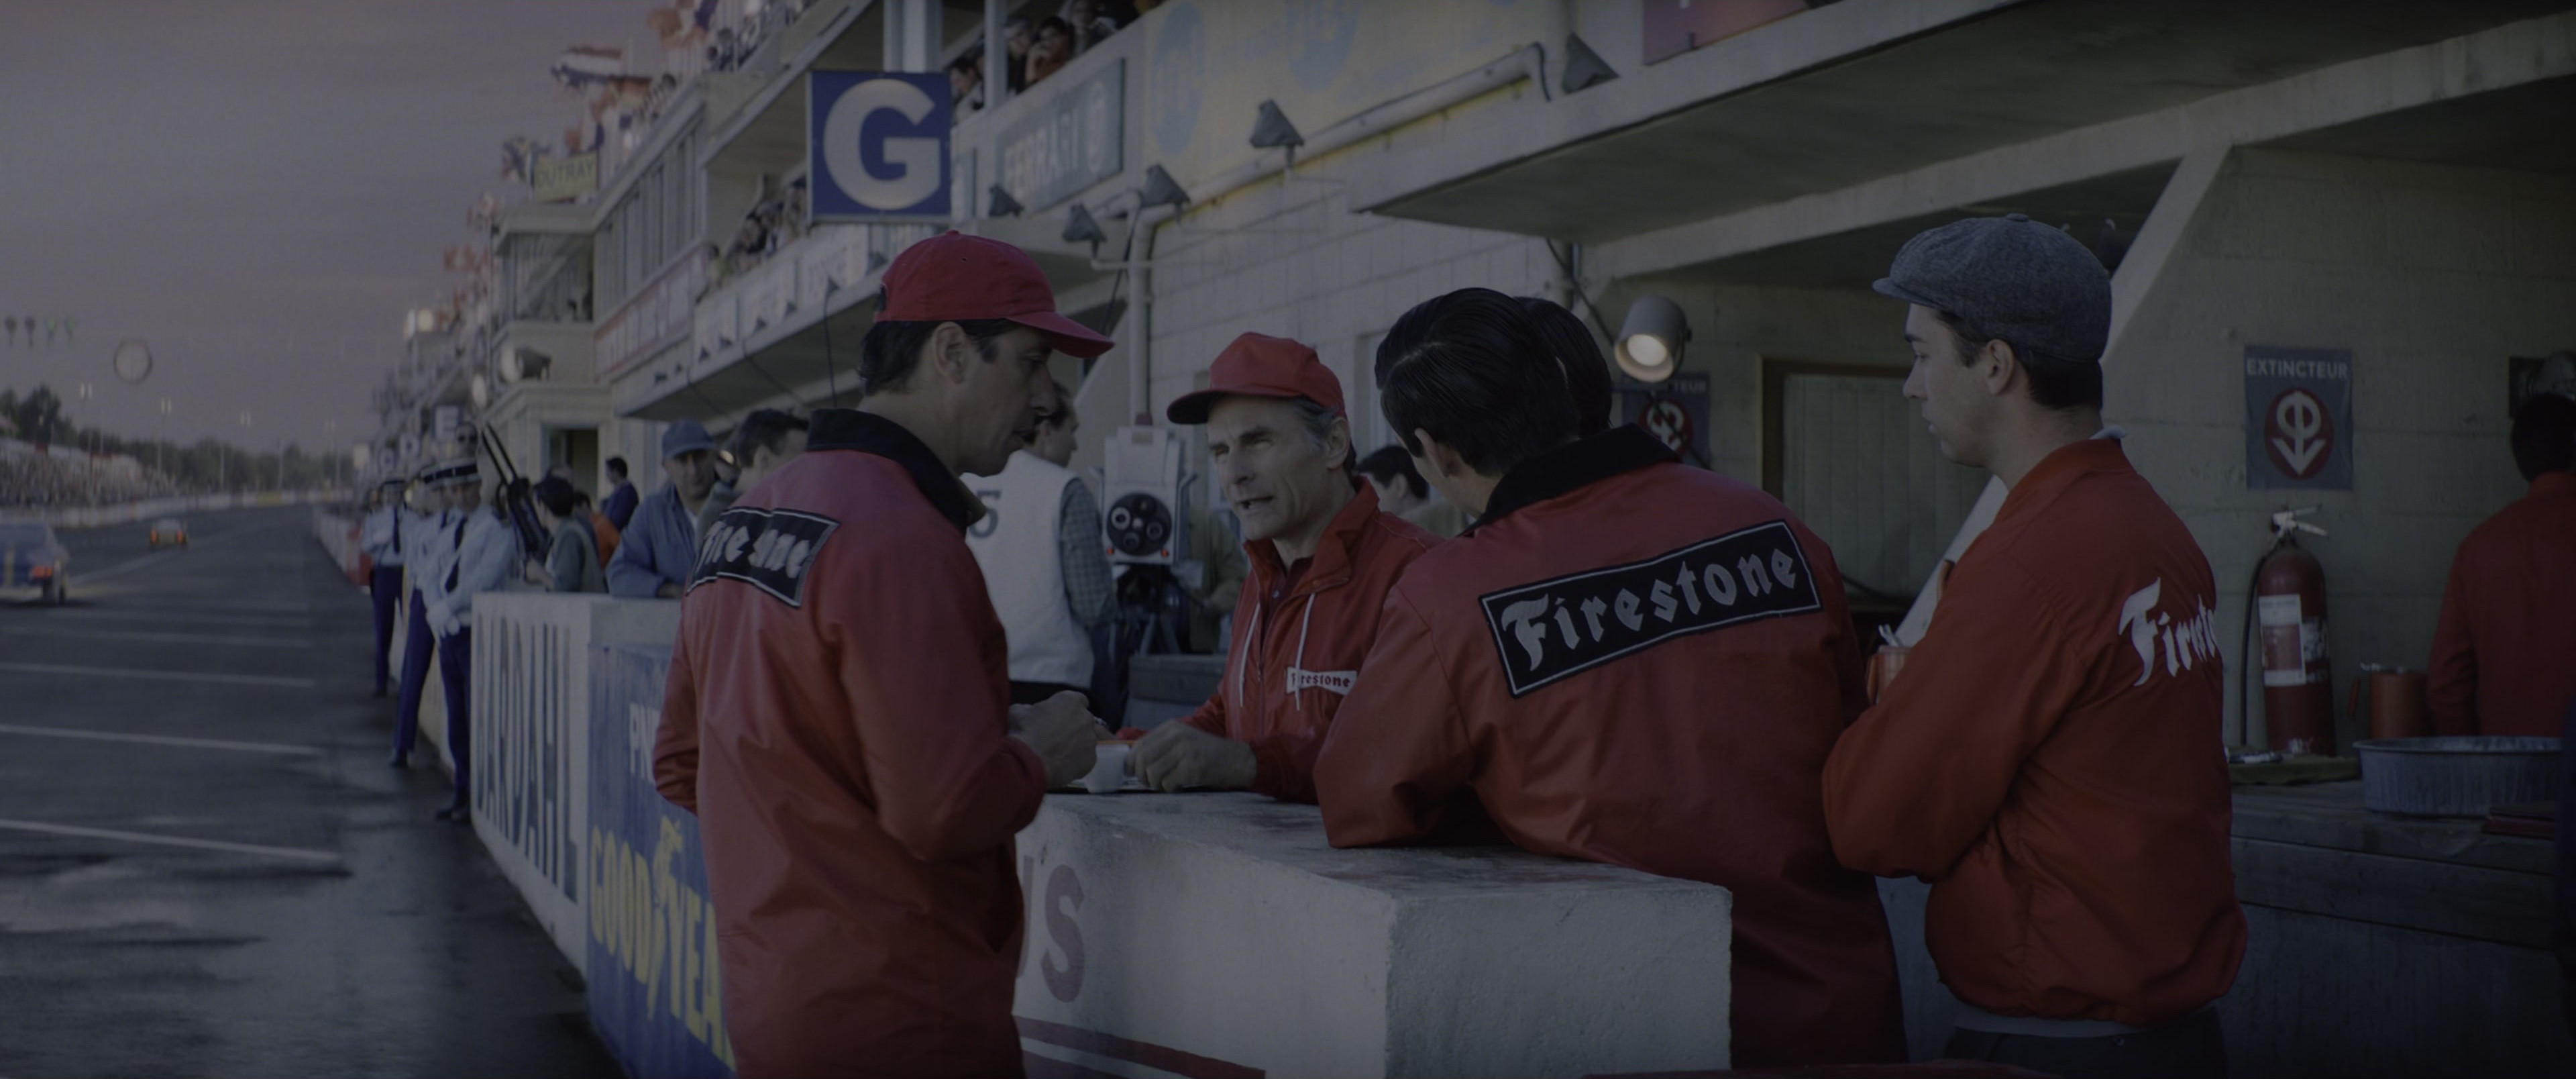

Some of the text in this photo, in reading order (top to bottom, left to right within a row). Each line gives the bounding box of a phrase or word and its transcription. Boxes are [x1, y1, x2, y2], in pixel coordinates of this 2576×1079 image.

[822, 77, 942, 211] G
[2245, 357, 2350, 382] EXTINCTEUR
[1500, 546, 1799, 673] Firestone
[1291, 671, 1352, 688] Frestone
[590, 823, 737, 1072] GOODYEA
